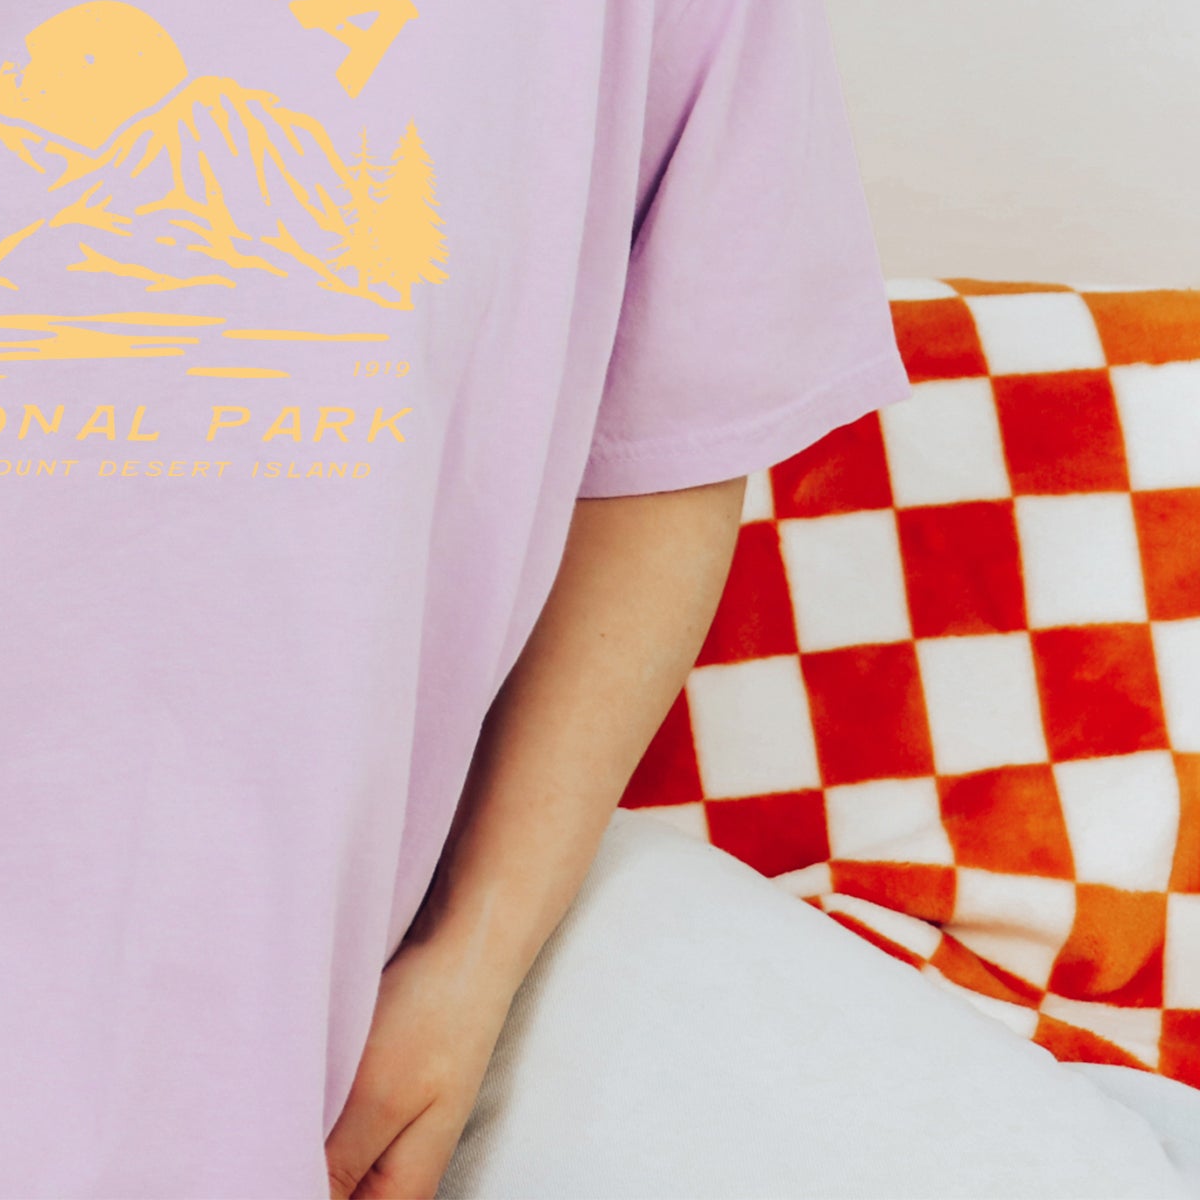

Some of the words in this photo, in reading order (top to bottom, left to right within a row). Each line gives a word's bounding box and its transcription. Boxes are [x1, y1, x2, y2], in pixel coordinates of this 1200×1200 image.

[352, 360, 411, 378] 1919
[206, 405, 413, 443] PARK
[98, 459, 232, 478] DESERT
[251, 461, 371, 479] ISLAND
